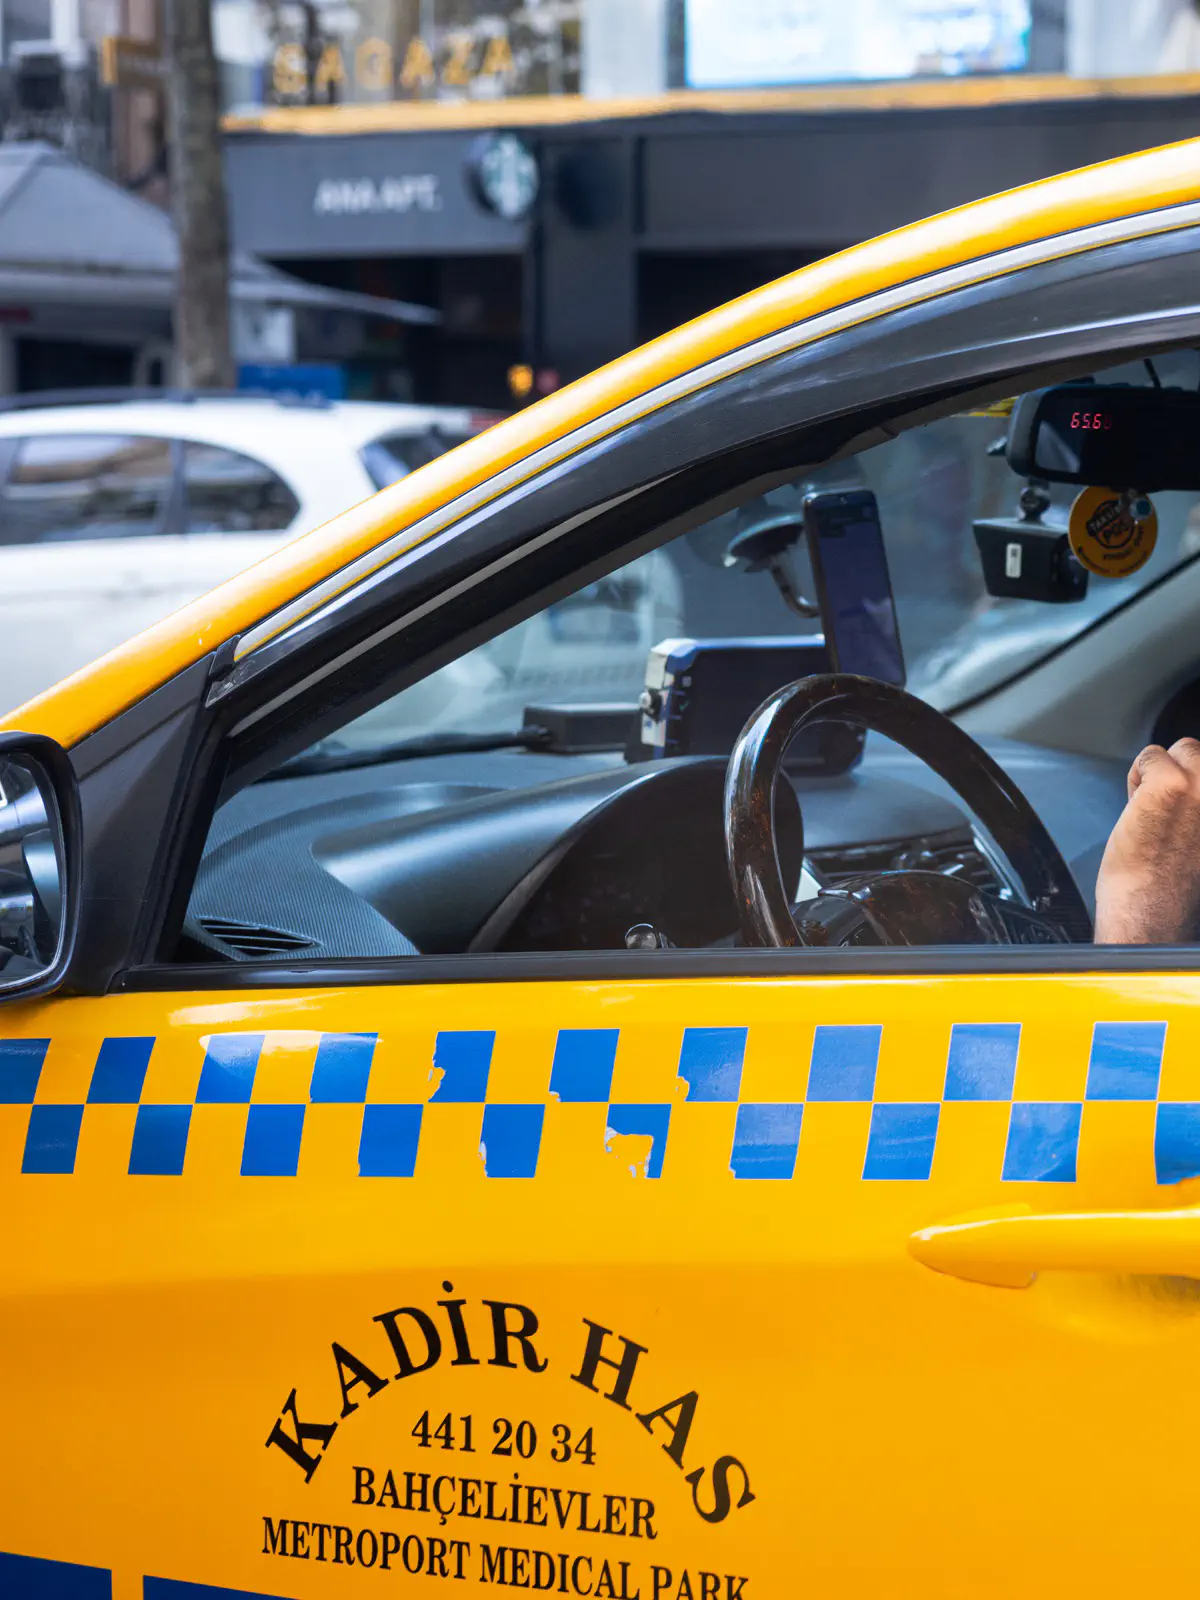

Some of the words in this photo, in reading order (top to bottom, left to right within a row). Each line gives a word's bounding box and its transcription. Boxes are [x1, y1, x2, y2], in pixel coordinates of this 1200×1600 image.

[264, 1280, 550, 1485] KADİR
[570, 1317, 756, 1524] HAS
[411, 1410, 477, 1454] 441
[491, 1418, 538, 1459] 20
[551, 1424, 597, 1465] 34
[351, 1466, 658, 1541] BAHÇELİEVLER
[261, 1516, 472, 1581] METROPORT
[479, 1543, 641, 1600] MEDICAL
[650, 1565, 749, 1600] PARK
